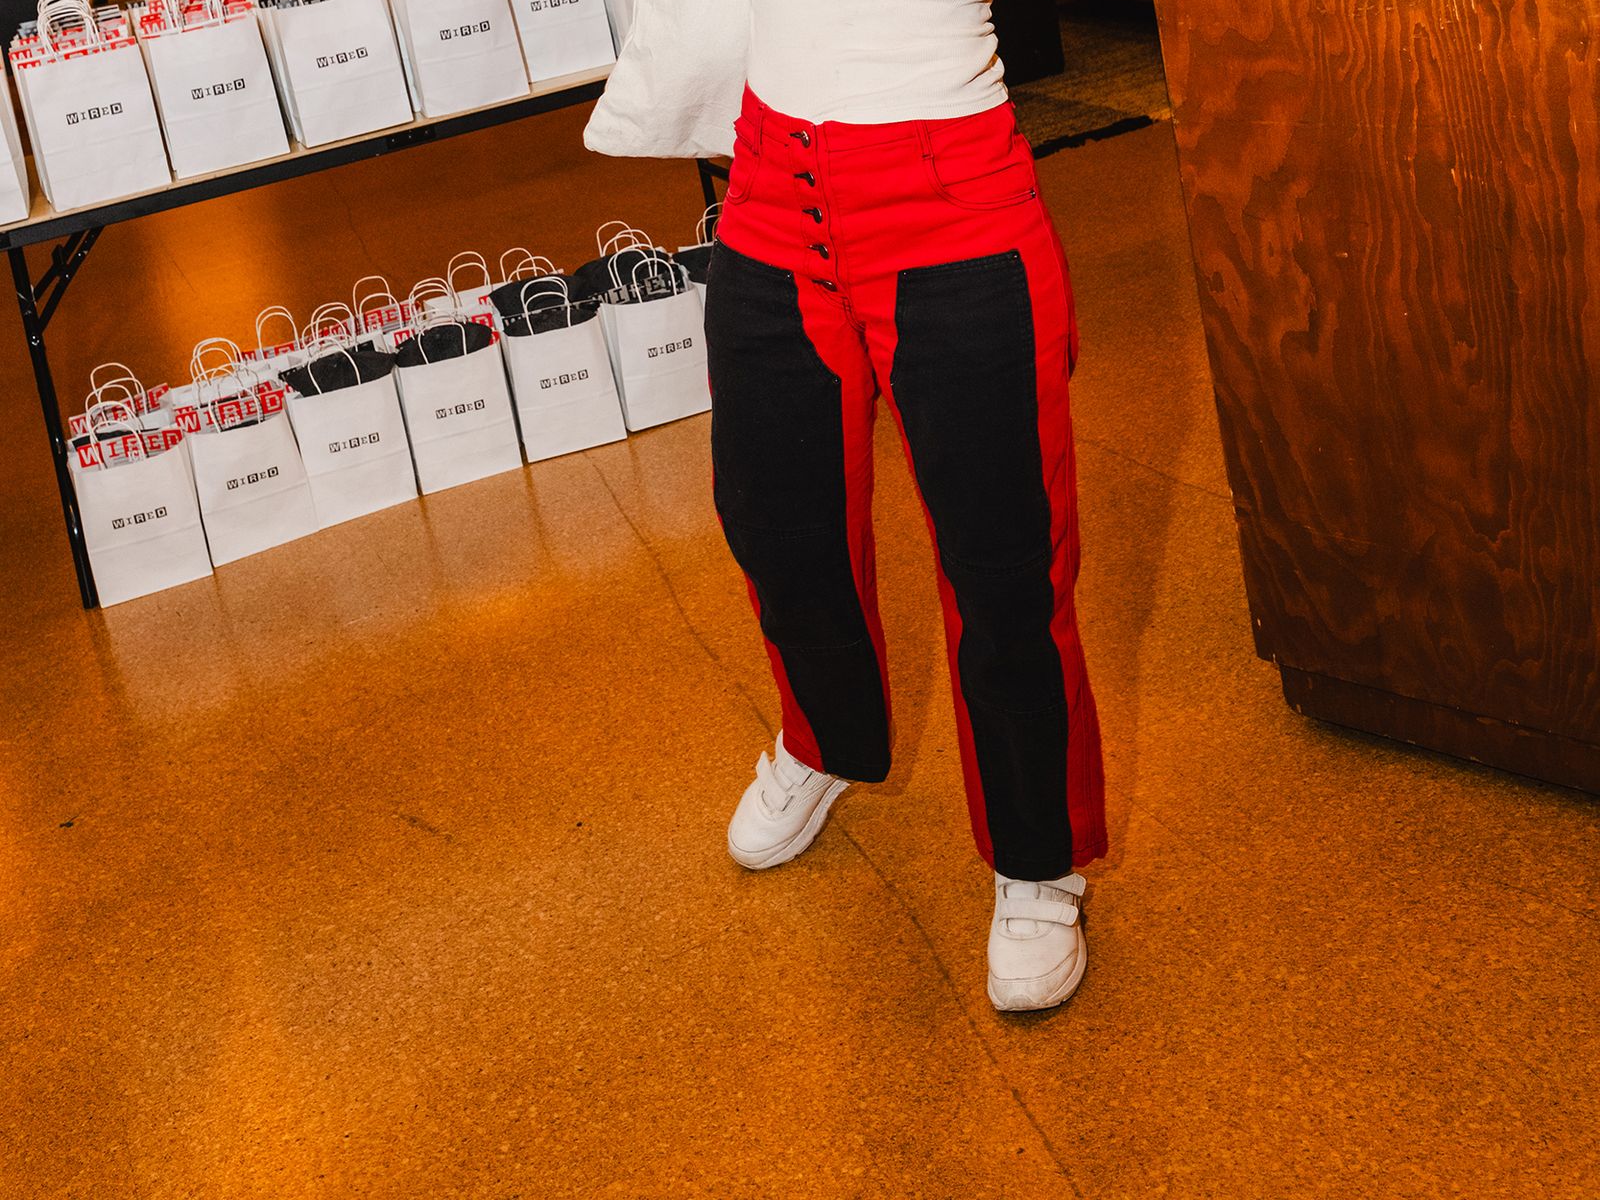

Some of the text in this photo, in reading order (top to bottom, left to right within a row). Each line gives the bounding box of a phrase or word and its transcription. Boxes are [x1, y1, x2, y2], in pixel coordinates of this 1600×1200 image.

[440, 21, 490, 40] WIRED
[317, 48, 368, 68] WIRED
[192, 78, 245, 99] WIRED
[66, 103, 123, 125] WIRED
[648, 338, 692, 358] WIRED
[540, 369, 588, 389] WIRED
[175, 390, 285, 434] WIRED
[436, 399, 485, 419] WIRED
[77, 429, 183, 468] WIRED
[329, 432, 380, 453] WIRED
[227, 467, 278, 490] WIRED
[112, 507, 167, 529] WIRED
